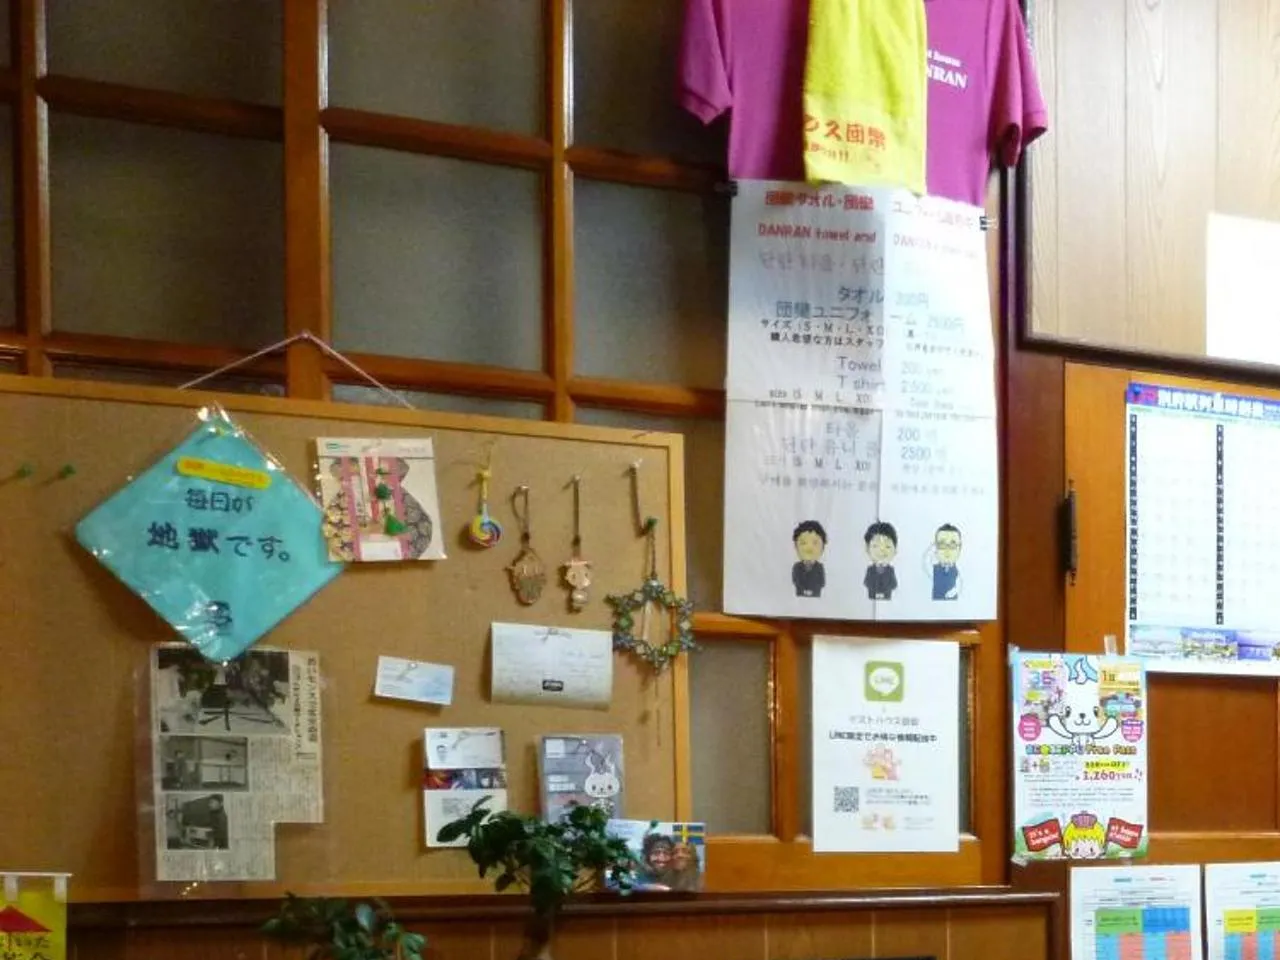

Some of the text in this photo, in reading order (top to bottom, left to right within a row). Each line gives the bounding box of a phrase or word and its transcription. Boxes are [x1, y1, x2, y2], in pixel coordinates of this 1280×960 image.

[758, 223, 812, 238] DANRAN
[838, 356, 882, 373] Towel
[185, 487, 254, 513] 毎日が
